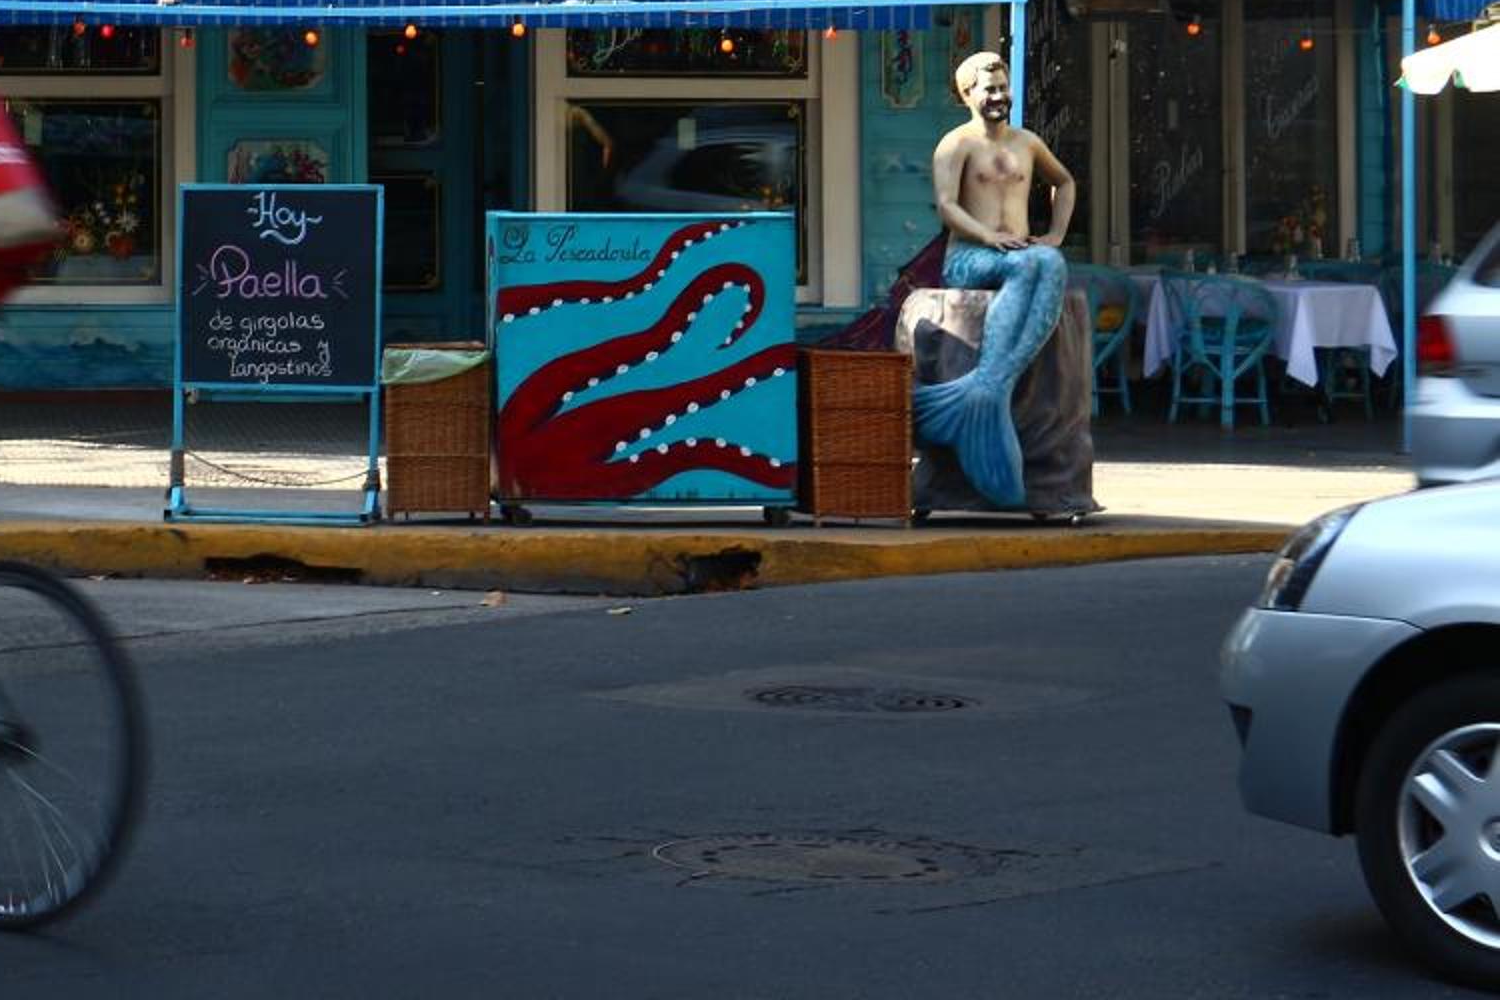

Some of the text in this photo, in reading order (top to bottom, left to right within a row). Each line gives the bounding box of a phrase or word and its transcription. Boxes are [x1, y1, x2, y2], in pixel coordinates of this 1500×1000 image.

[252, 191, 310, 245] Hoy
[499, 225, 536, 264] La
[210, 244, 328, 299] Paella
[208, 308, 234, 331] de
[317, 339, 331, 367] y
